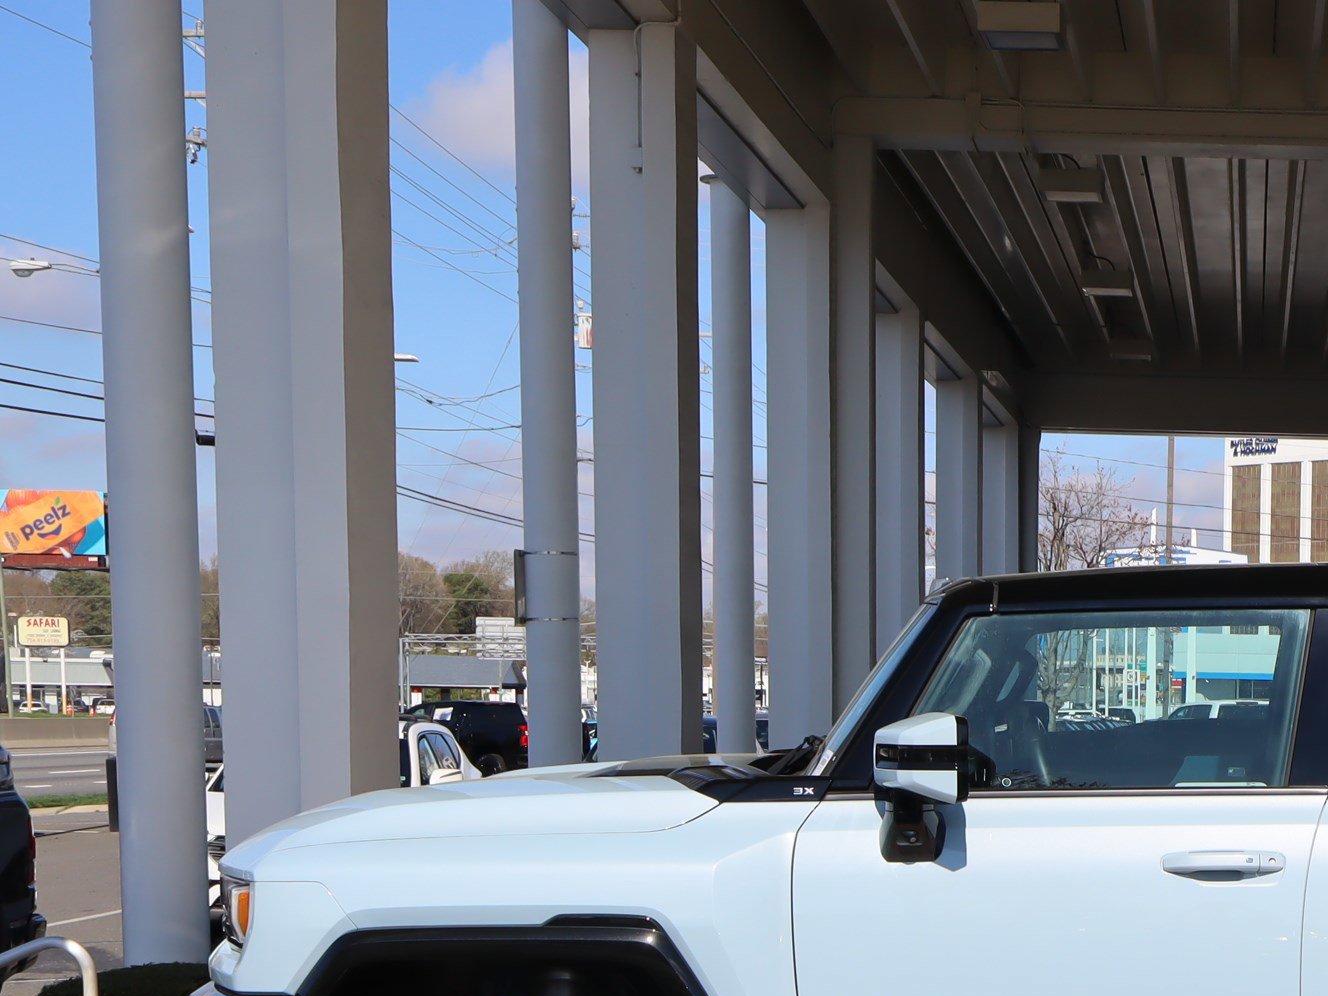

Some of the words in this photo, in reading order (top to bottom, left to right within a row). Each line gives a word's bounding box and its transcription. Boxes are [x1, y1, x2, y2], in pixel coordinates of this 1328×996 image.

[20, 504, 71, 541] peelz
[26, 618, 60, 627] SAFARI
[793, 787, 814, 795] 3X
